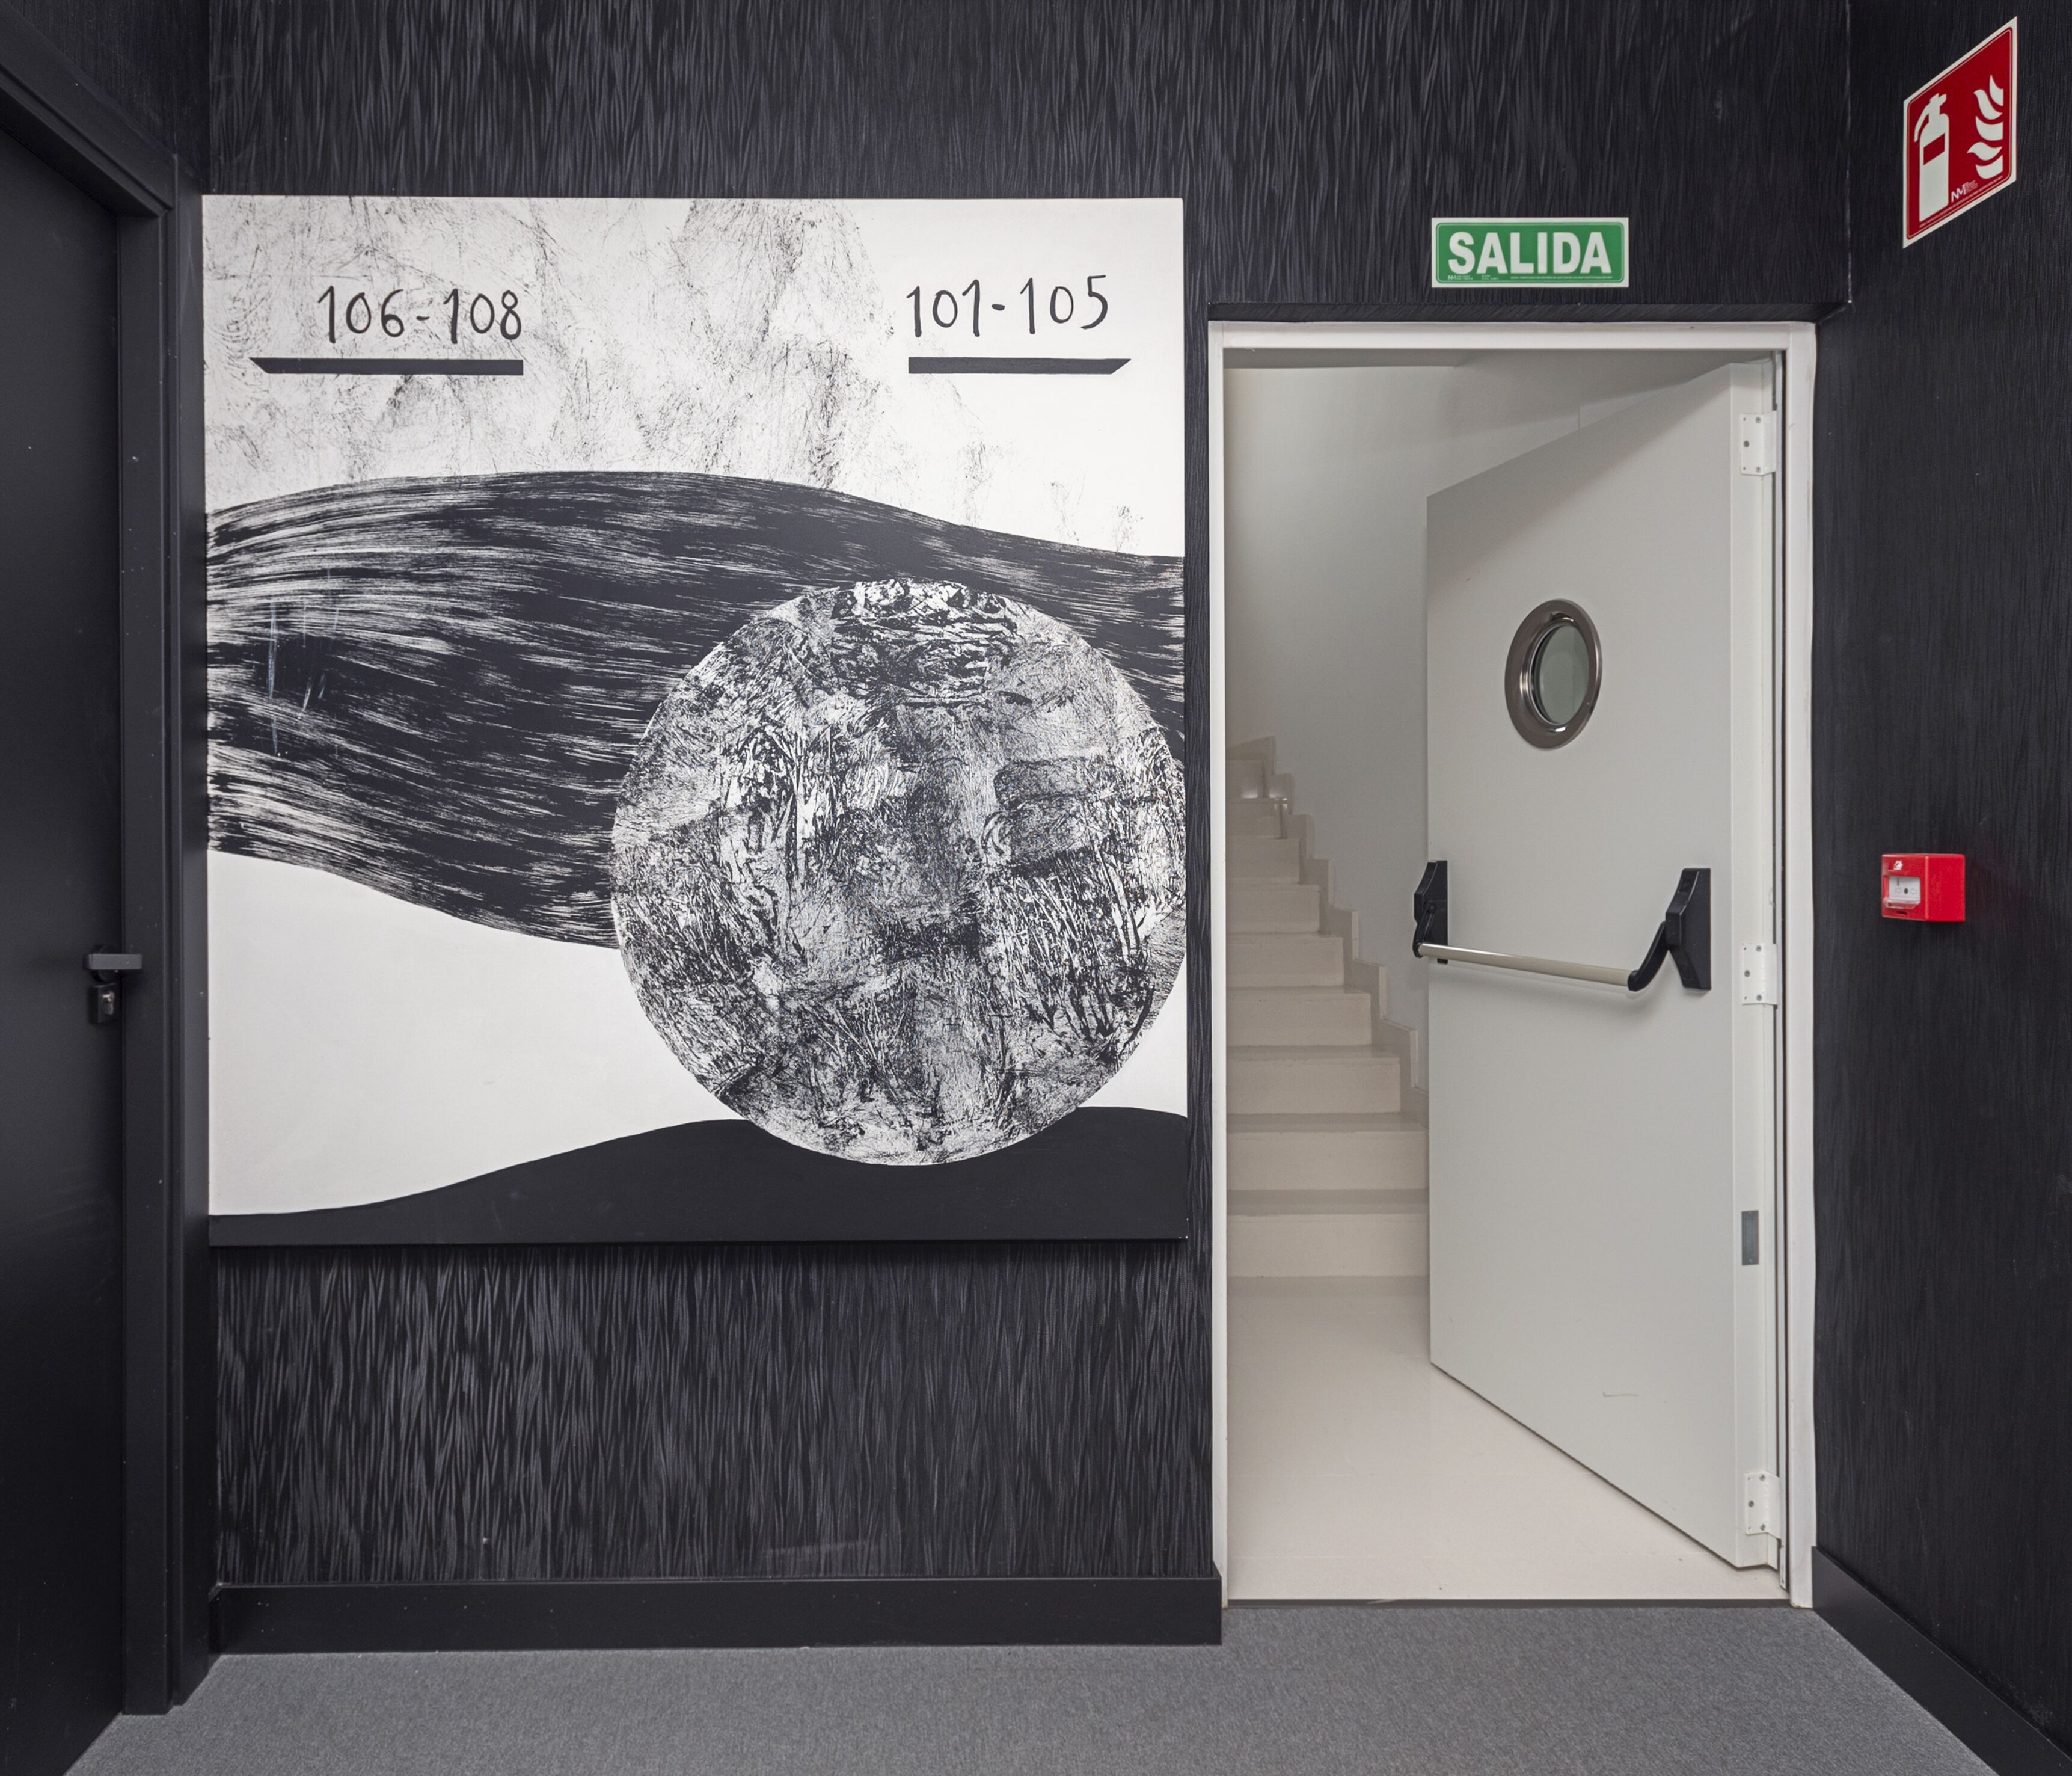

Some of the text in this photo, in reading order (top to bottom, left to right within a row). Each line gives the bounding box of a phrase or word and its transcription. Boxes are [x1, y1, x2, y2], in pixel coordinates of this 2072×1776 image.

[1448, 231, 1612, 274] SALIDA
[317, 285, 522, 344] 106-108
[906, 274, 1108, 338] 101-105
